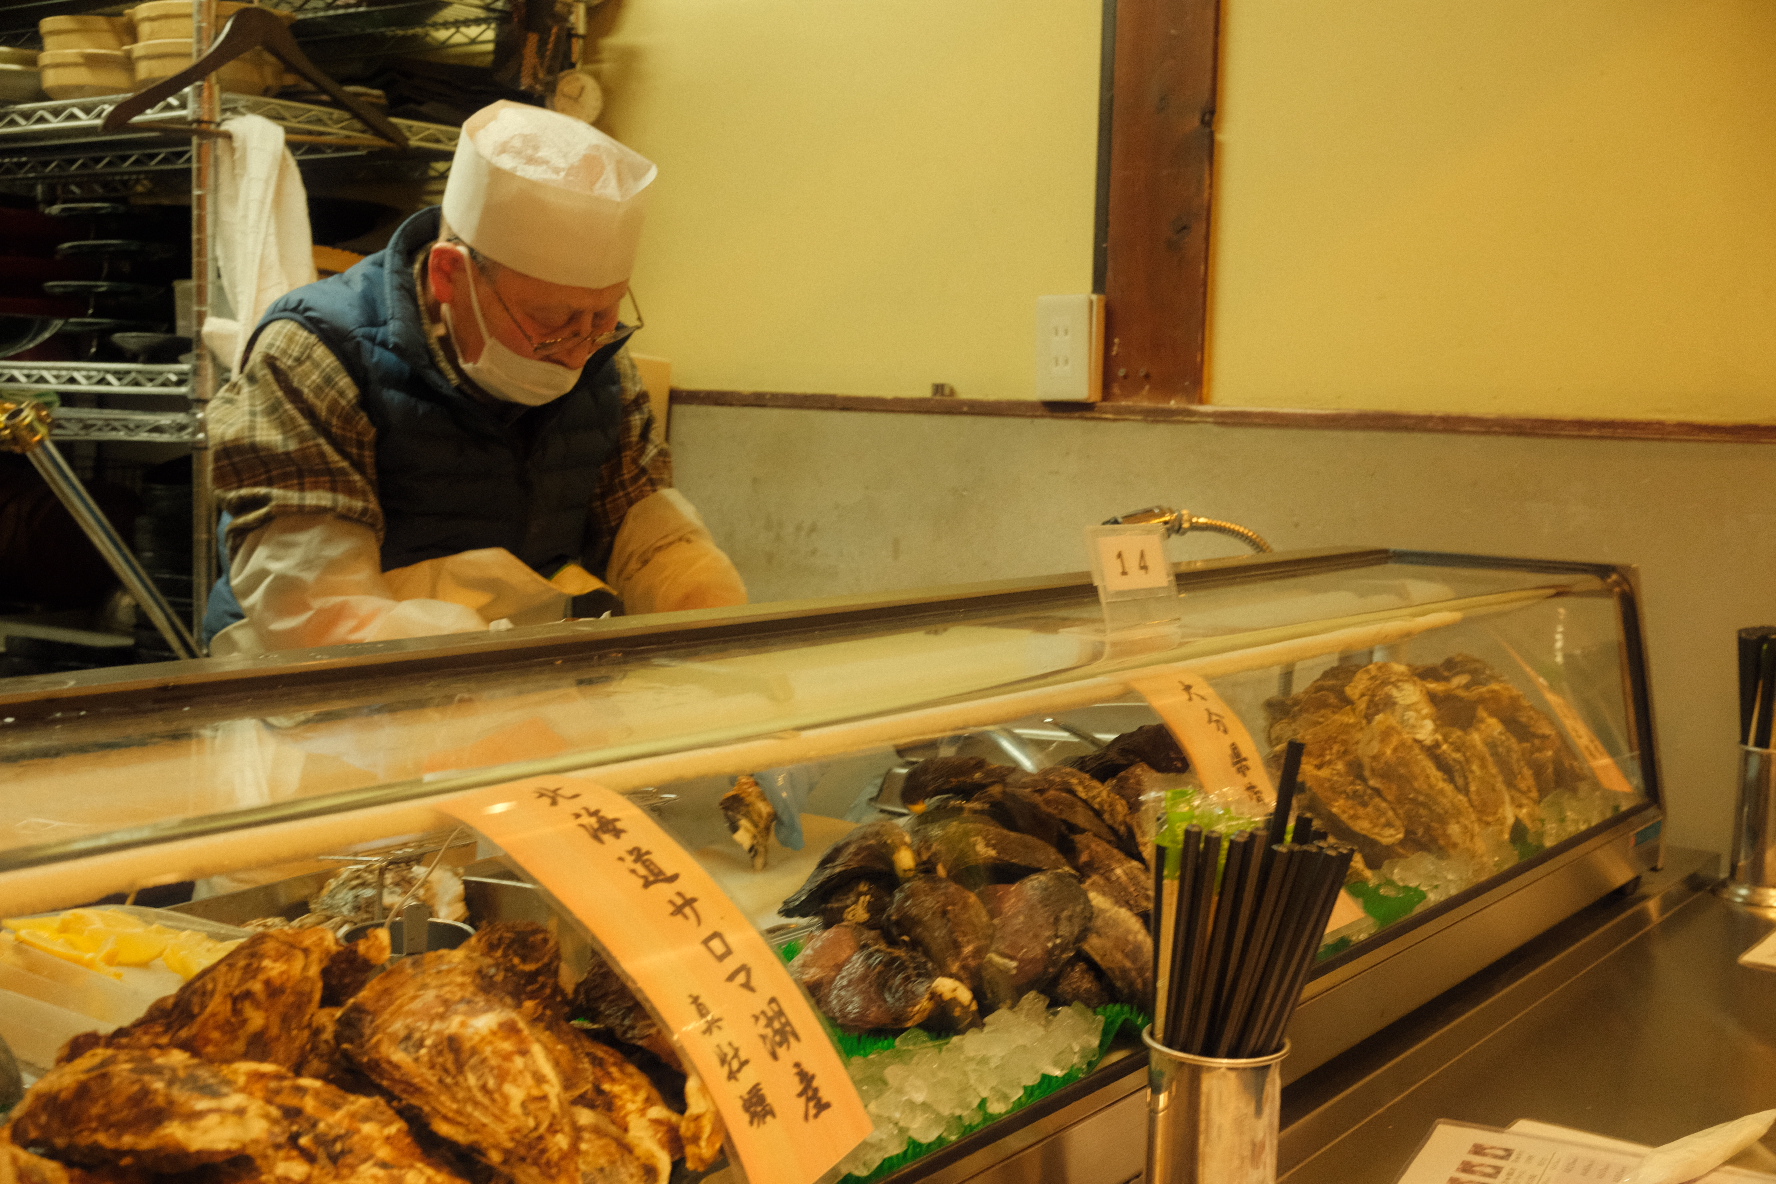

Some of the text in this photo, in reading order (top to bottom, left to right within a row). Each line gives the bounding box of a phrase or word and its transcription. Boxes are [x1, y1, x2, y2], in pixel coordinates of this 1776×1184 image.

[1116, 549, 1149, 576] 14
[534, 786, 831, 1122] 北海道サロマ湖産
